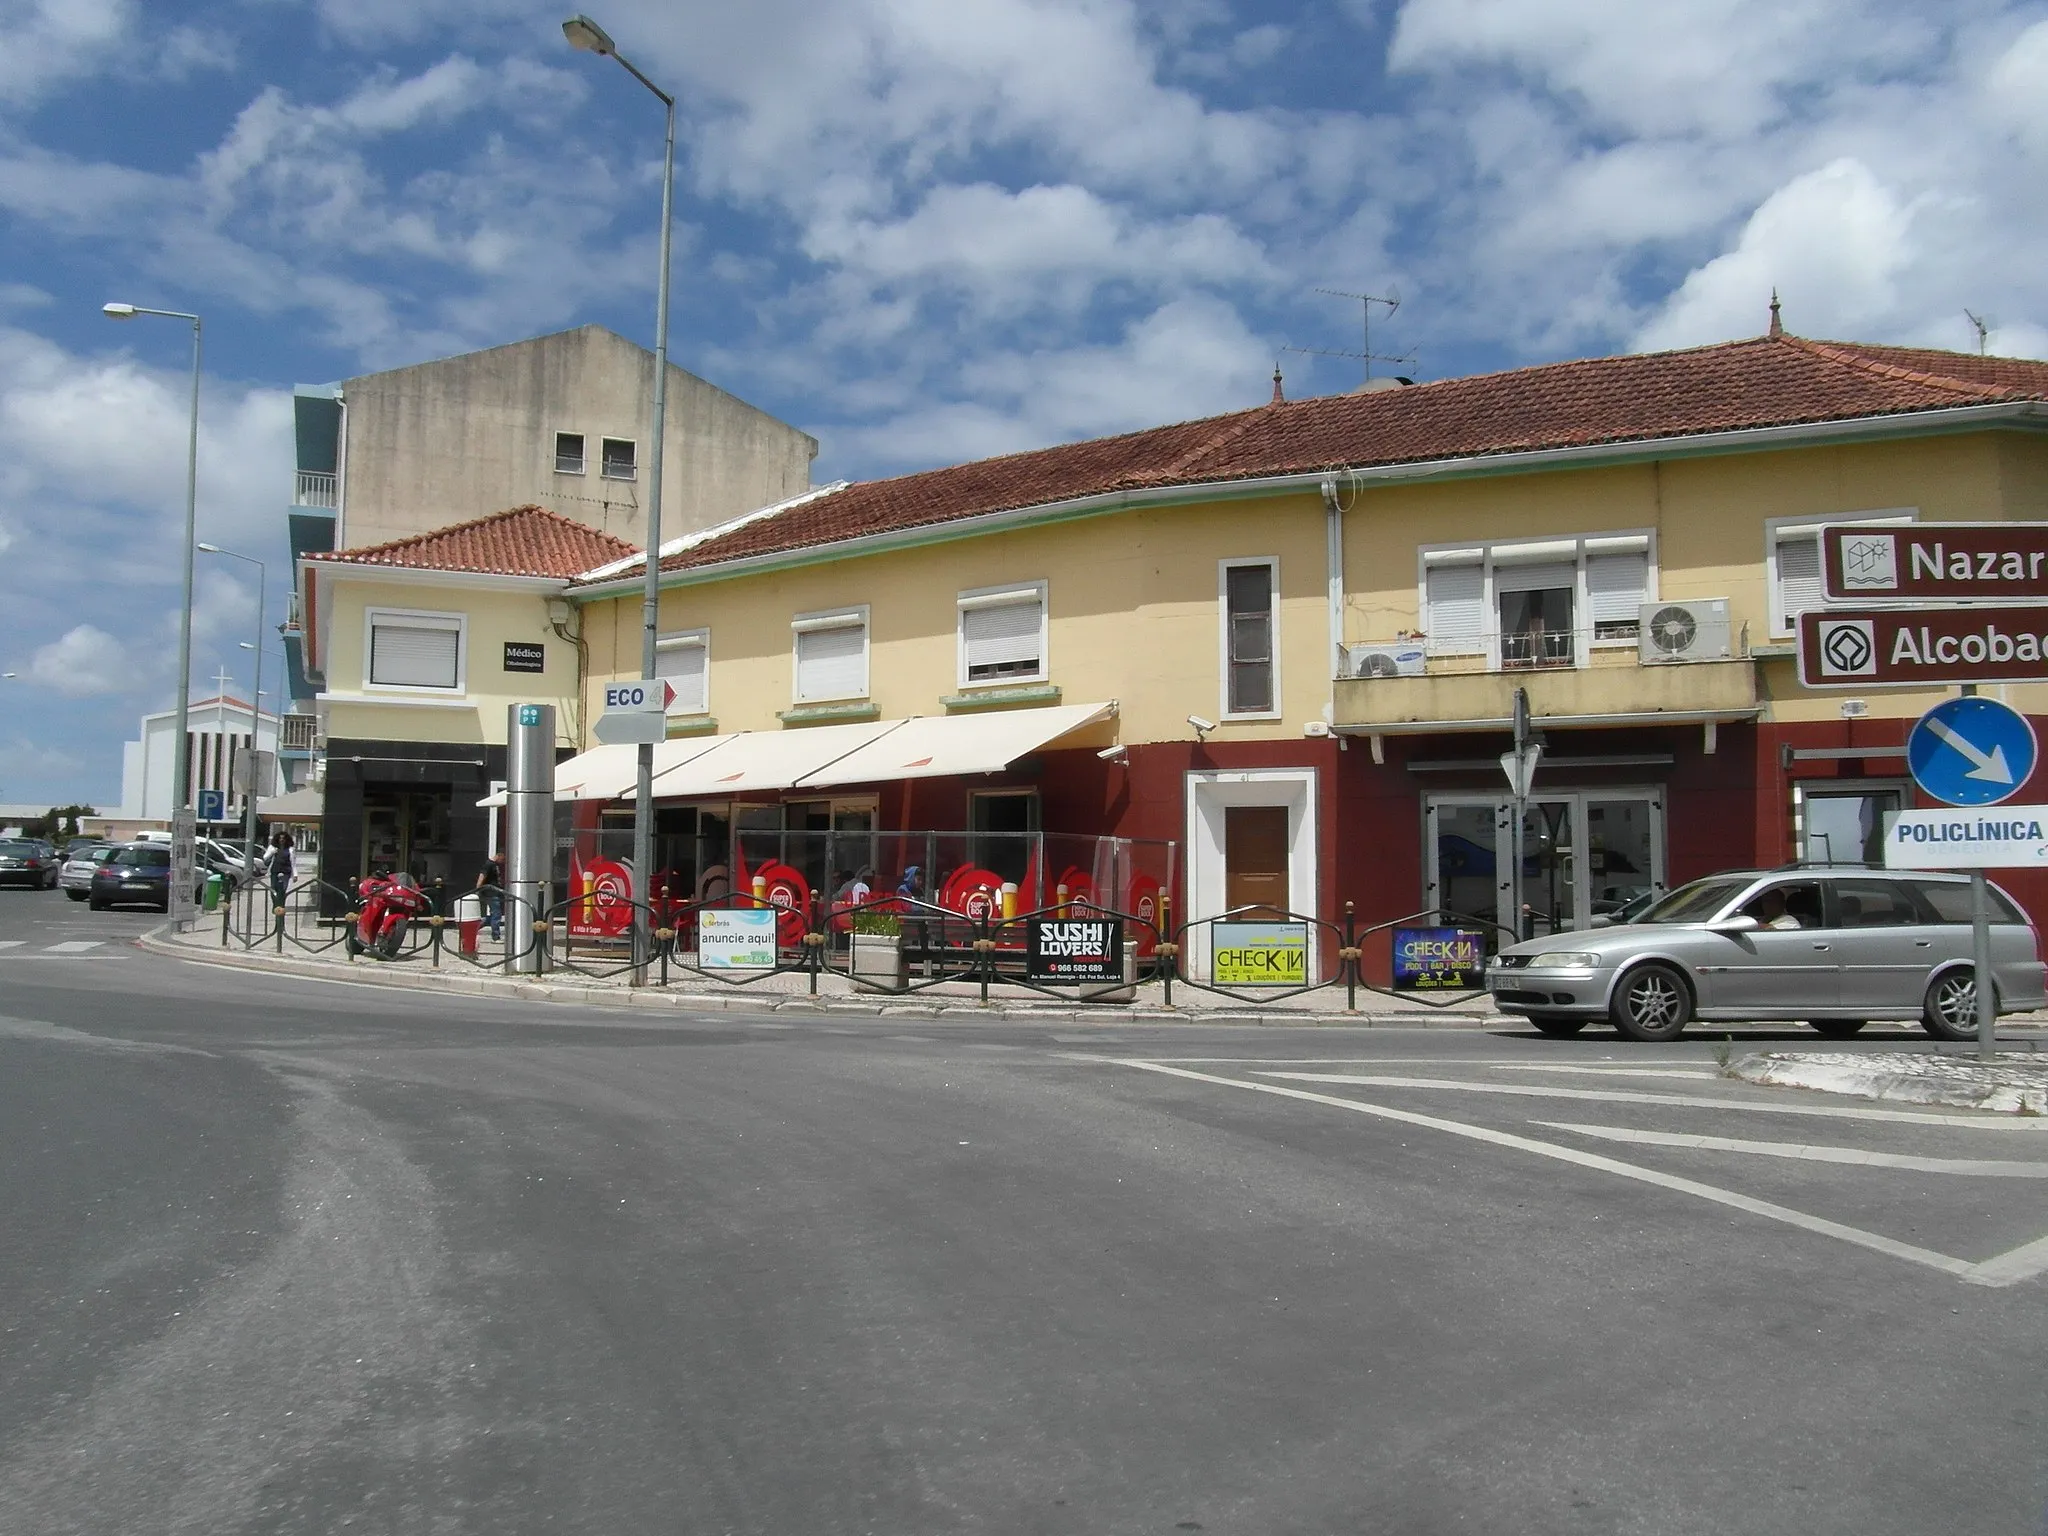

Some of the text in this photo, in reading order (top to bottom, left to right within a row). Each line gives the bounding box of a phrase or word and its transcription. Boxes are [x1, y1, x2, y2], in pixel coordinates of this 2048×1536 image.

[506, 648, 542, 658] Médico
[1891, 624, 2048, 665] Alcoba
[606, 687, 644, 706] ECO
[203, 793, 219, 817] P
[1898, 817, 2044, 843] POLICLÍNICA
[702, 932, 775, 945] anuncie aqui!
[1039, 923, 1103, 942] SUSHI
[1039, 941, 1103, 956] LOVERS
[1073, 964, 1088, 972] 582
[1088, 964, 1103, 972] 689
[1405, 961, 1472, 971] POOL BAR DISCO
